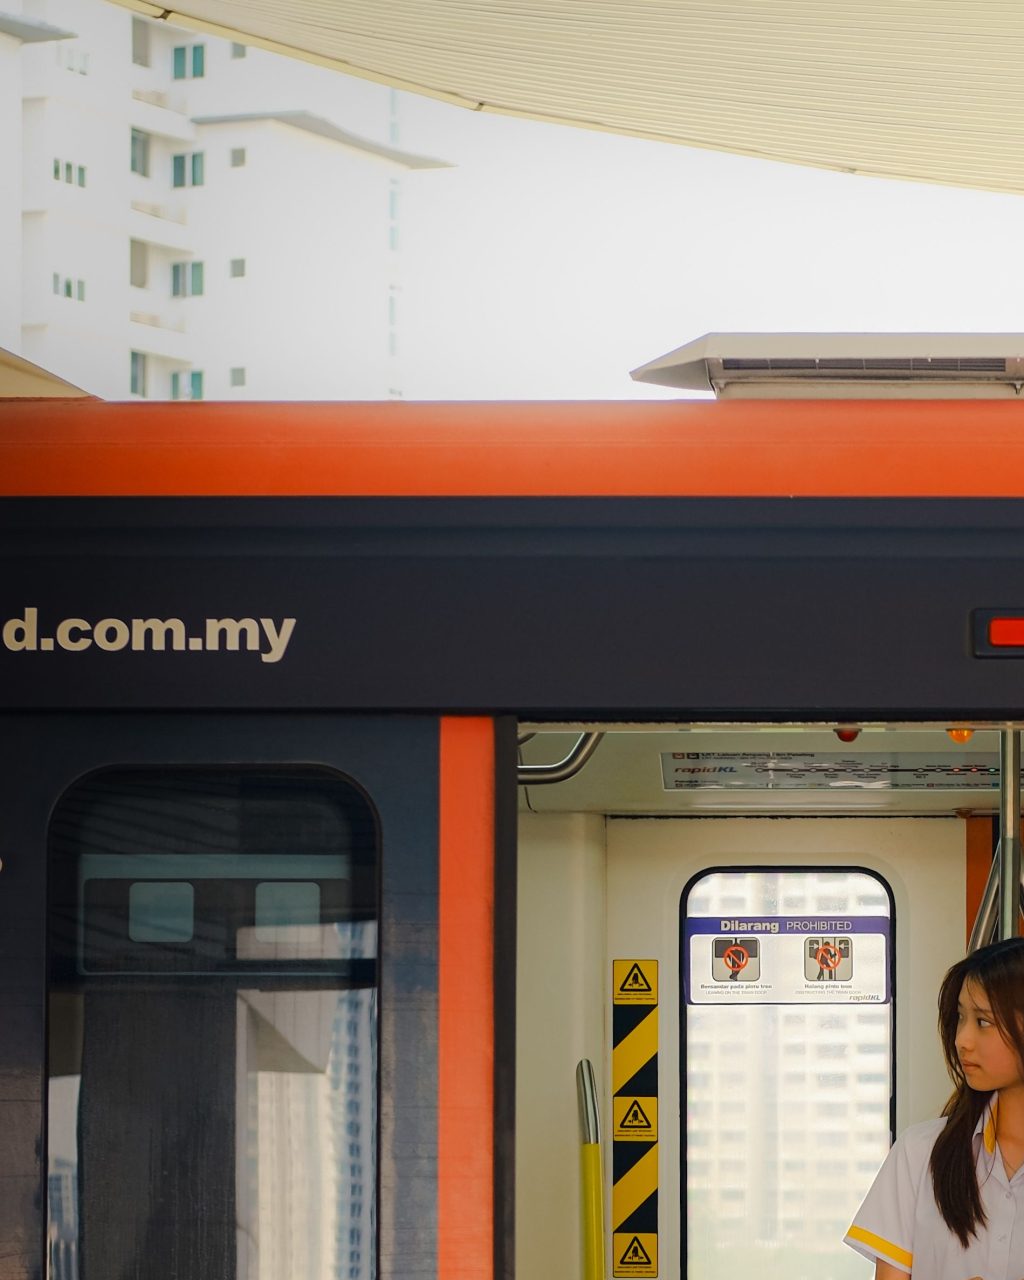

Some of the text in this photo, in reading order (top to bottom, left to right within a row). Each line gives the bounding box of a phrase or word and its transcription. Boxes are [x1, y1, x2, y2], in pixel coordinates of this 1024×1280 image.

[2, 607, 297, 663] d.com.my
[675, 766, 738, 774] rapidKL
[720, 920, 852, 933] Dilarang PROHIBITED
